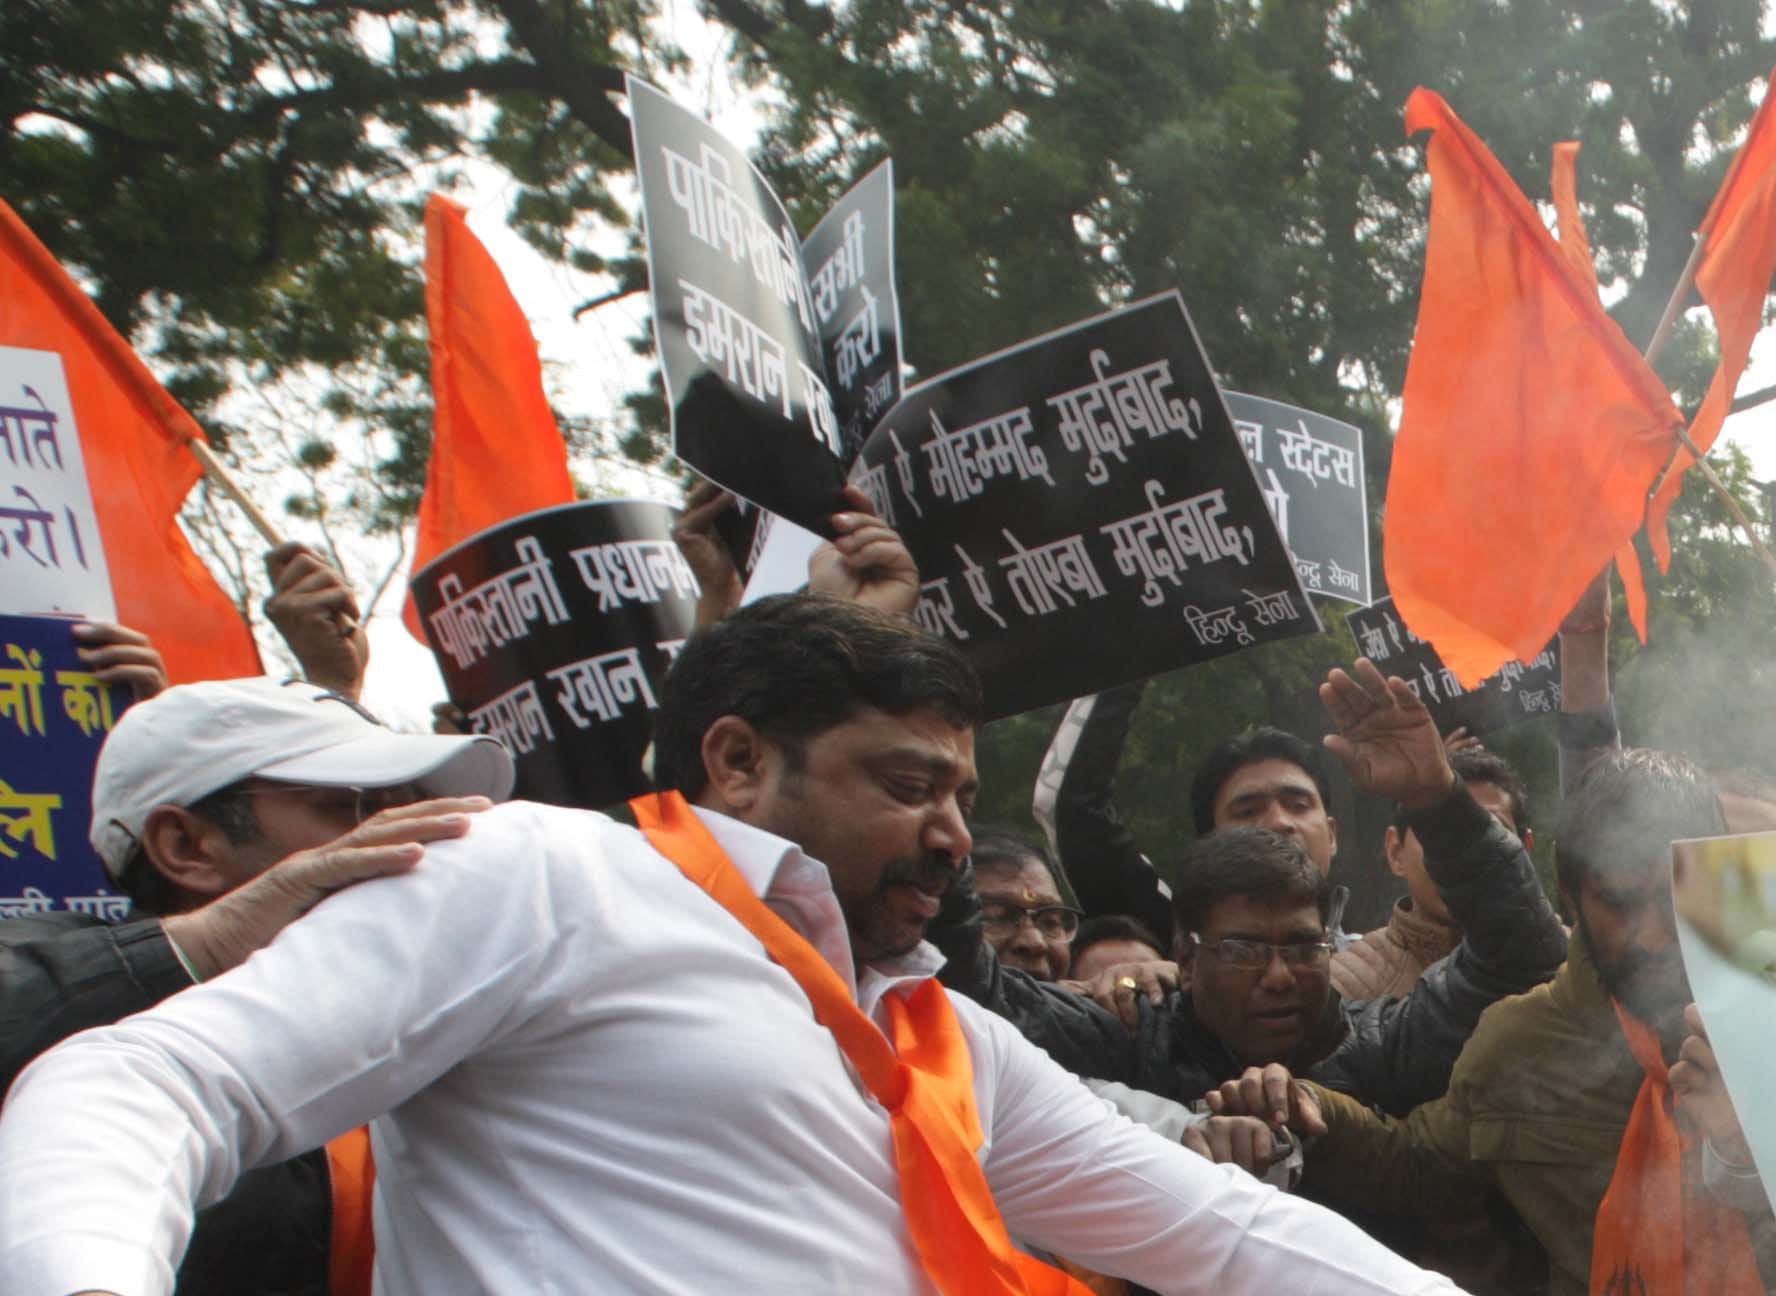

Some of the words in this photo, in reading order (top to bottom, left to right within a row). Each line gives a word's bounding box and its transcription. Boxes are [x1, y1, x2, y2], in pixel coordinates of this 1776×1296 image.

[811, 209, 866, 326] सभी
[677, 277, 794, 421] इमरान
[833, 284, 882, 391] करो
[920, 407, 1057, 503] मौहम्मद
[1046, 347, 1203, 486] मुर्दाबाद,
[428, 535, 572, 671] पाकिस्तानी
[998, 526, 1108, 616] तोएबा
[1099, 478, 1255, 608] मुर्दाबाद,
[1328, 556, 1360, 592] सेना
[1184, 603, 1256, 645] हिन्दू
[1241, 588, 1300, 626] सेना
